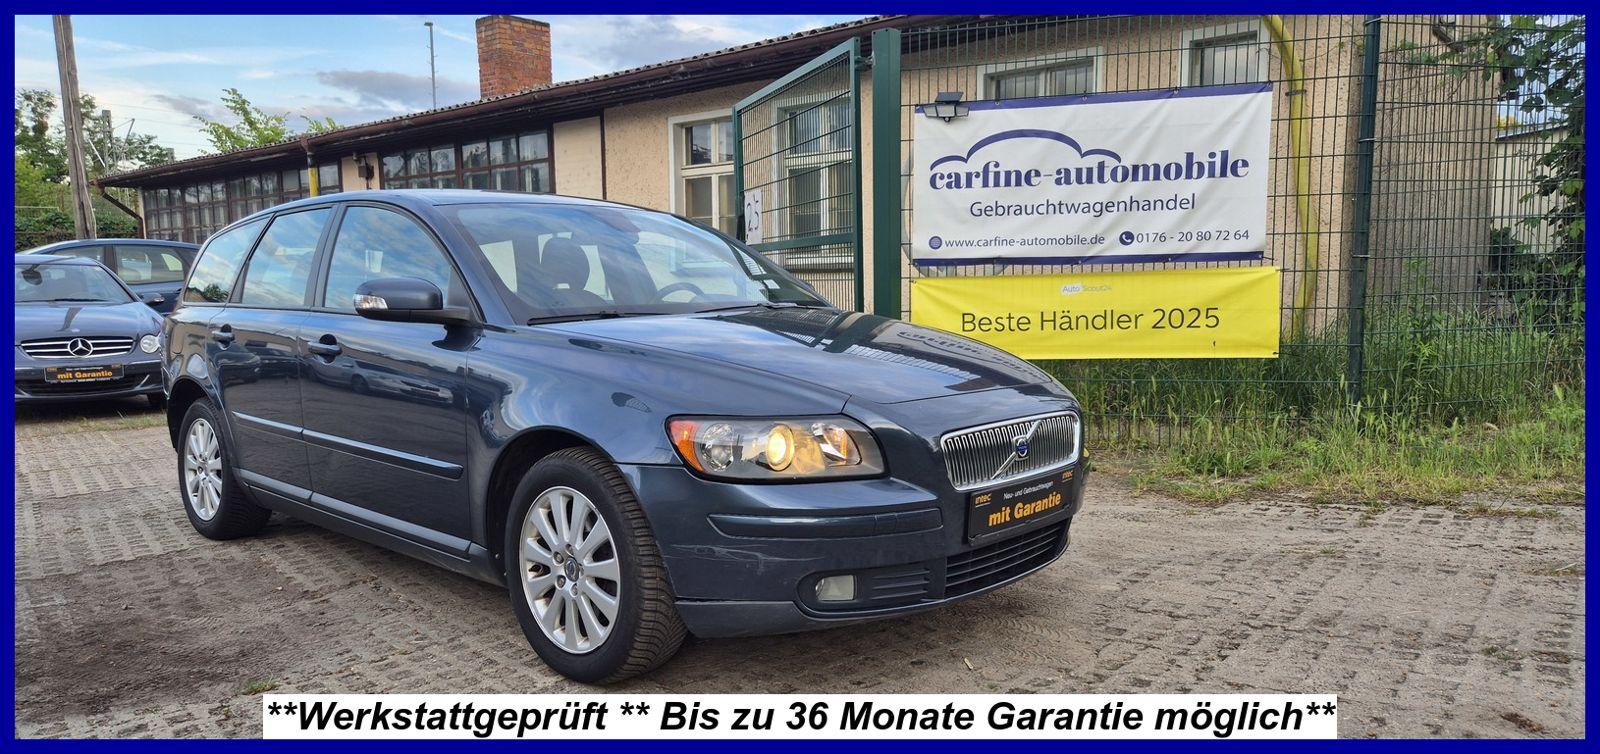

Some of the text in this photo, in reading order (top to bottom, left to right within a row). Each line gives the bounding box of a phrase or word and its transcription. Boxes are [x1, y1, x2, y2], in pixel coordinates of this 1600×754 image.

[929, 149, 1250, 190] carfine-automobile
[969, 193, 1196, 218] Gebrauchtwagenhandel
[944, 234, 1105, 248] www.carfine-automobile.de
[1136, 232, 1167, 244] 0176
[1177, 231, 1193, 243] 20
[1195, 231, 1212, 242] 80
[1215, 230, 1230, 242] 72
[1233, 229, 1250, 241] 64
[961, 307, 1220, 333] Beste Händler 2025
[988, 492, 1062, 526] mit Garantie
